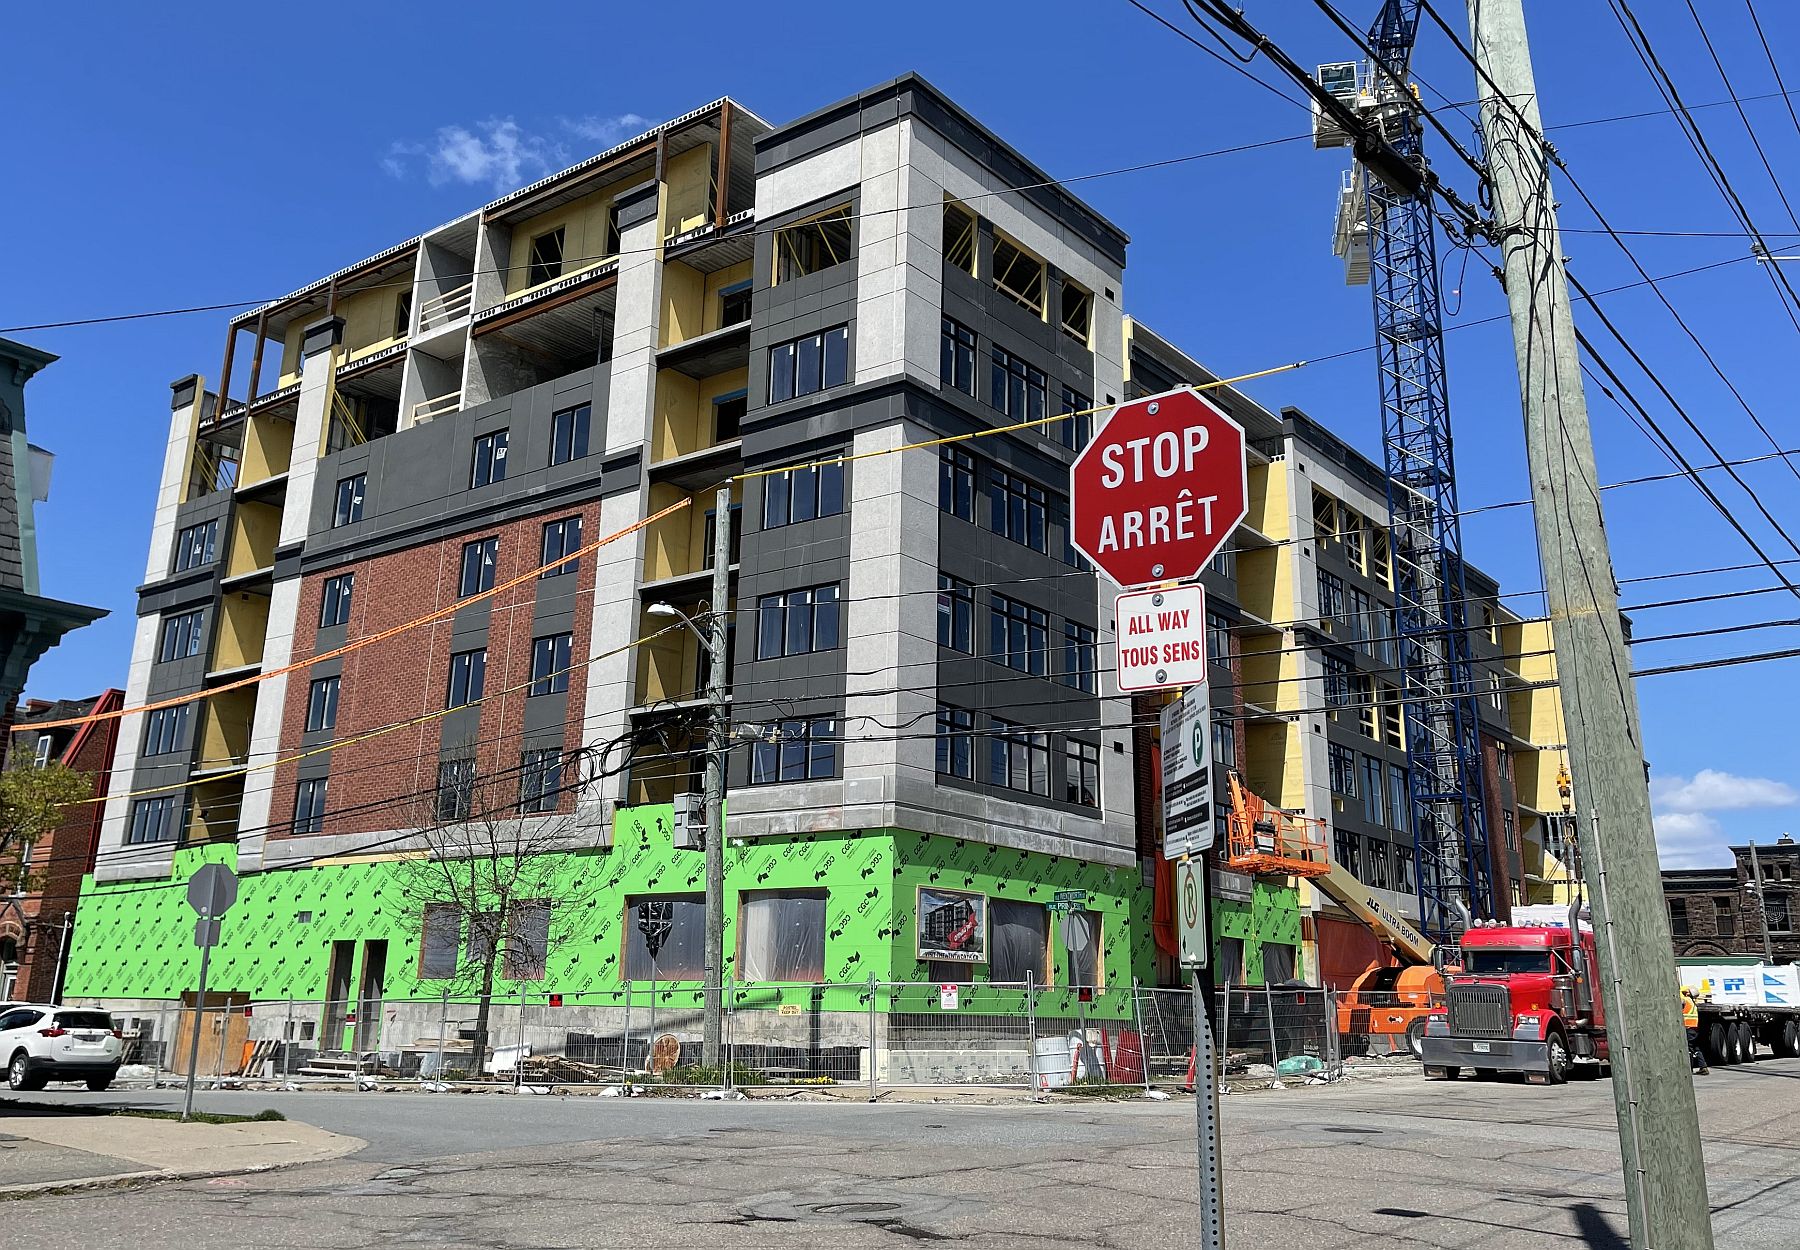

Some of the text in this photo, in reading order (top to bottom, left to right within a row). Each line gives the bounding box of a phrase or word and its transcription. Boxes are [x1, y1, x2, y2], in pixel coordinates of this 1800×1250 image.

[1101, 425, 1210, 489] STOP
[1098, 488, 1218, 554] ARRÊT
[1128, 609, 1190, 636] ALL WAY
[1122, 640, 1200, 668] TOUS SENS
[739, 847, 751, 860] CGC
[782, 843, 795, 858] CGC
[799, 842, 811, 857] CGC
[841, 840, 853, 855] CGC
[914, 842, 924, 855] CGC
[950, 847, 959, 860] CGC
[631, 850, 642, 864] CGC
[671, 850, 682, 864] CGC
[823, 855, 835, 870] CGC
[871, 853, 883, 868] CGC
[900, 855, 910, 869] CGC
[983, 852, 992, 865] CGC
[1014, 858, 1023, 870] CGC
[617, 864, 627, 878] CGC
[656, 864, 666, 878] CGC
[695, 862, 706, 877] CGC
[766, 859, 777, 873] CGC
[1045, 862, 1054, 875] CGC
[857, 899, 870, 914] CGC
[579, 908, 590, 921] CGC
[897, 914, 907, 929] CGC
[1366, 896, 1419, 947] JLG ULTRA BOOM
[601, 921, 611, 934] CGC
[839, 915, 851, 930] CGC
[563, 964, 574, 977] CGC
[597, 964, 608, 977] CGC
[838, 963, 851, 978] CGC
[911, 966, 921, 980] CGC
[582, 977, 593, 991] CGC
